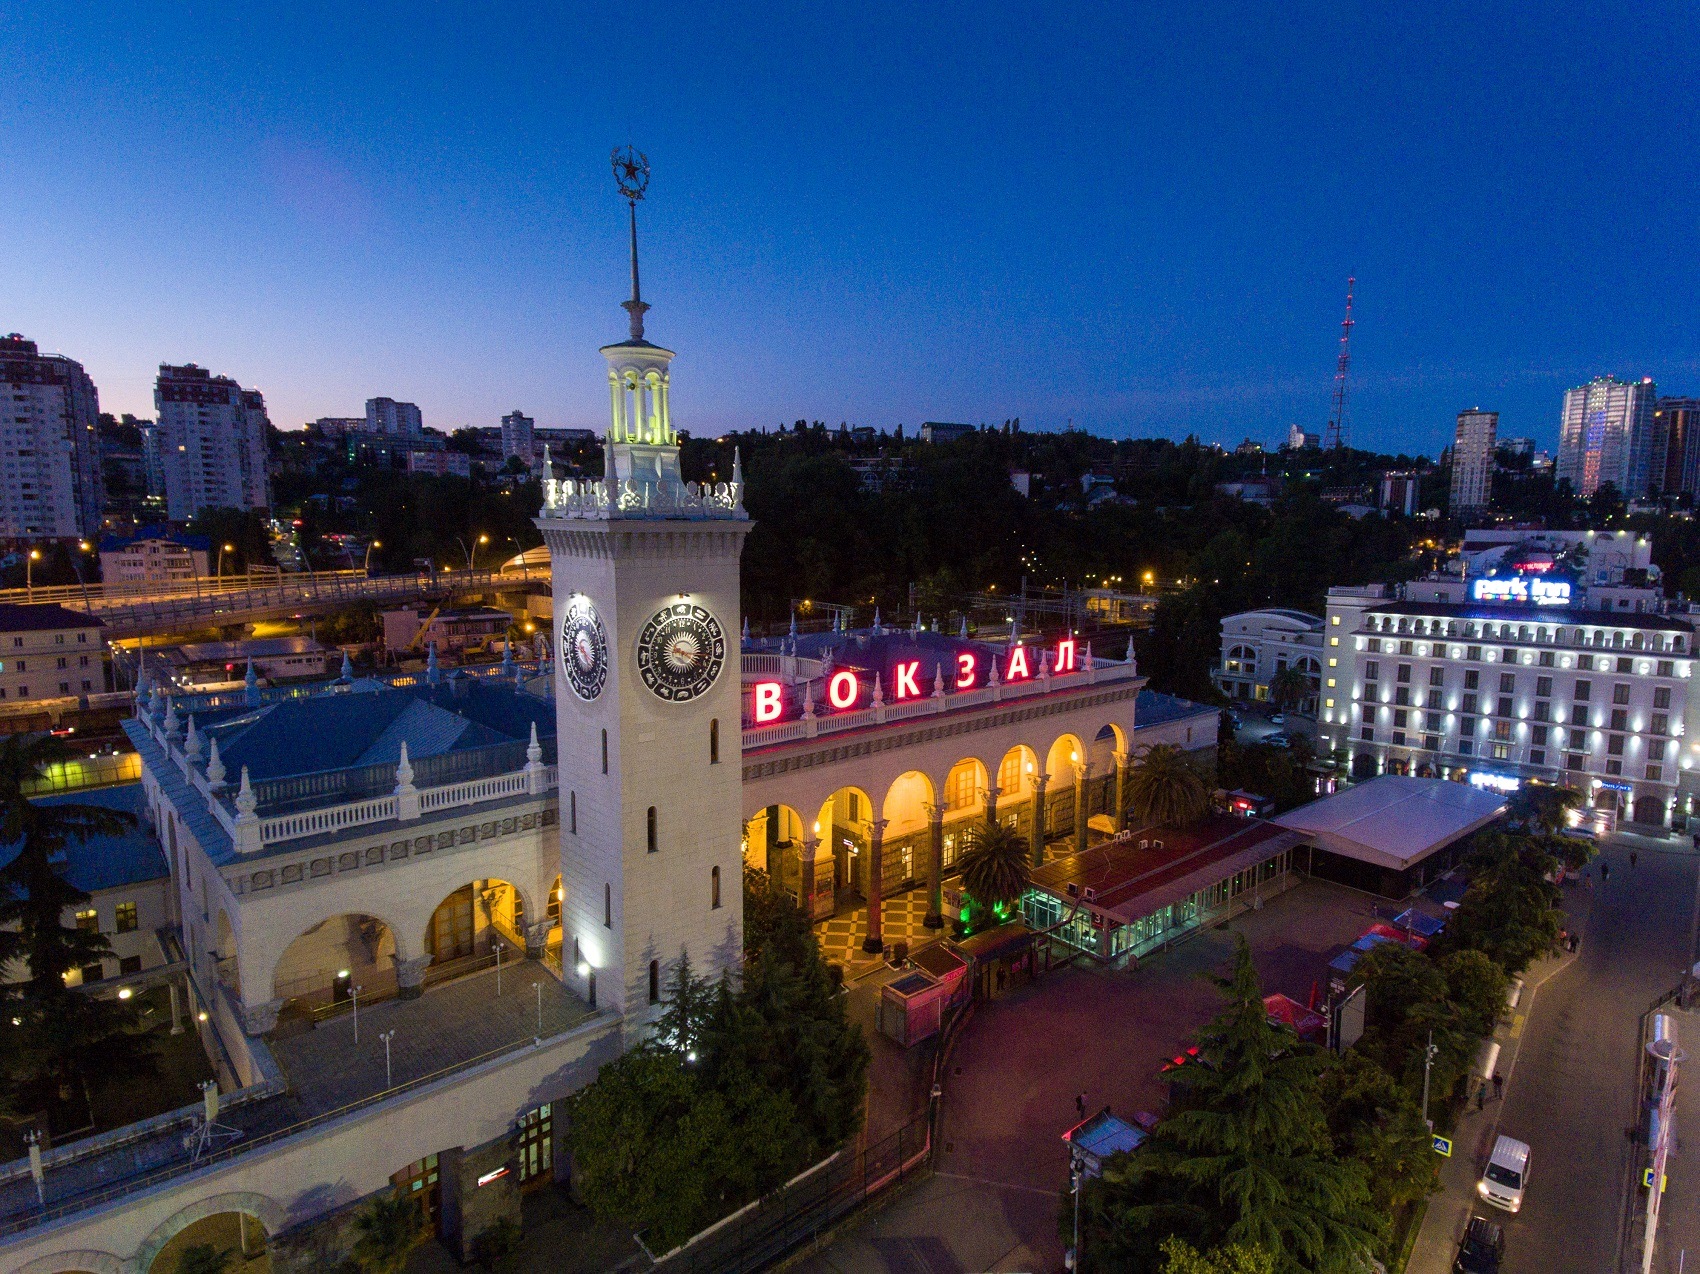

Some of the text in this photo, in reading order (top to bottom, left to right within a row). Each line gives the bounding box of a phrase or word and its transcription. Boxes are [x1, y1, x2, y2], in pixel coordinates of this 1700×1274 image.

[1475, 577, 1571, 599] park inn
[754, 640, 1074, 722] ВОКЗАЛ
